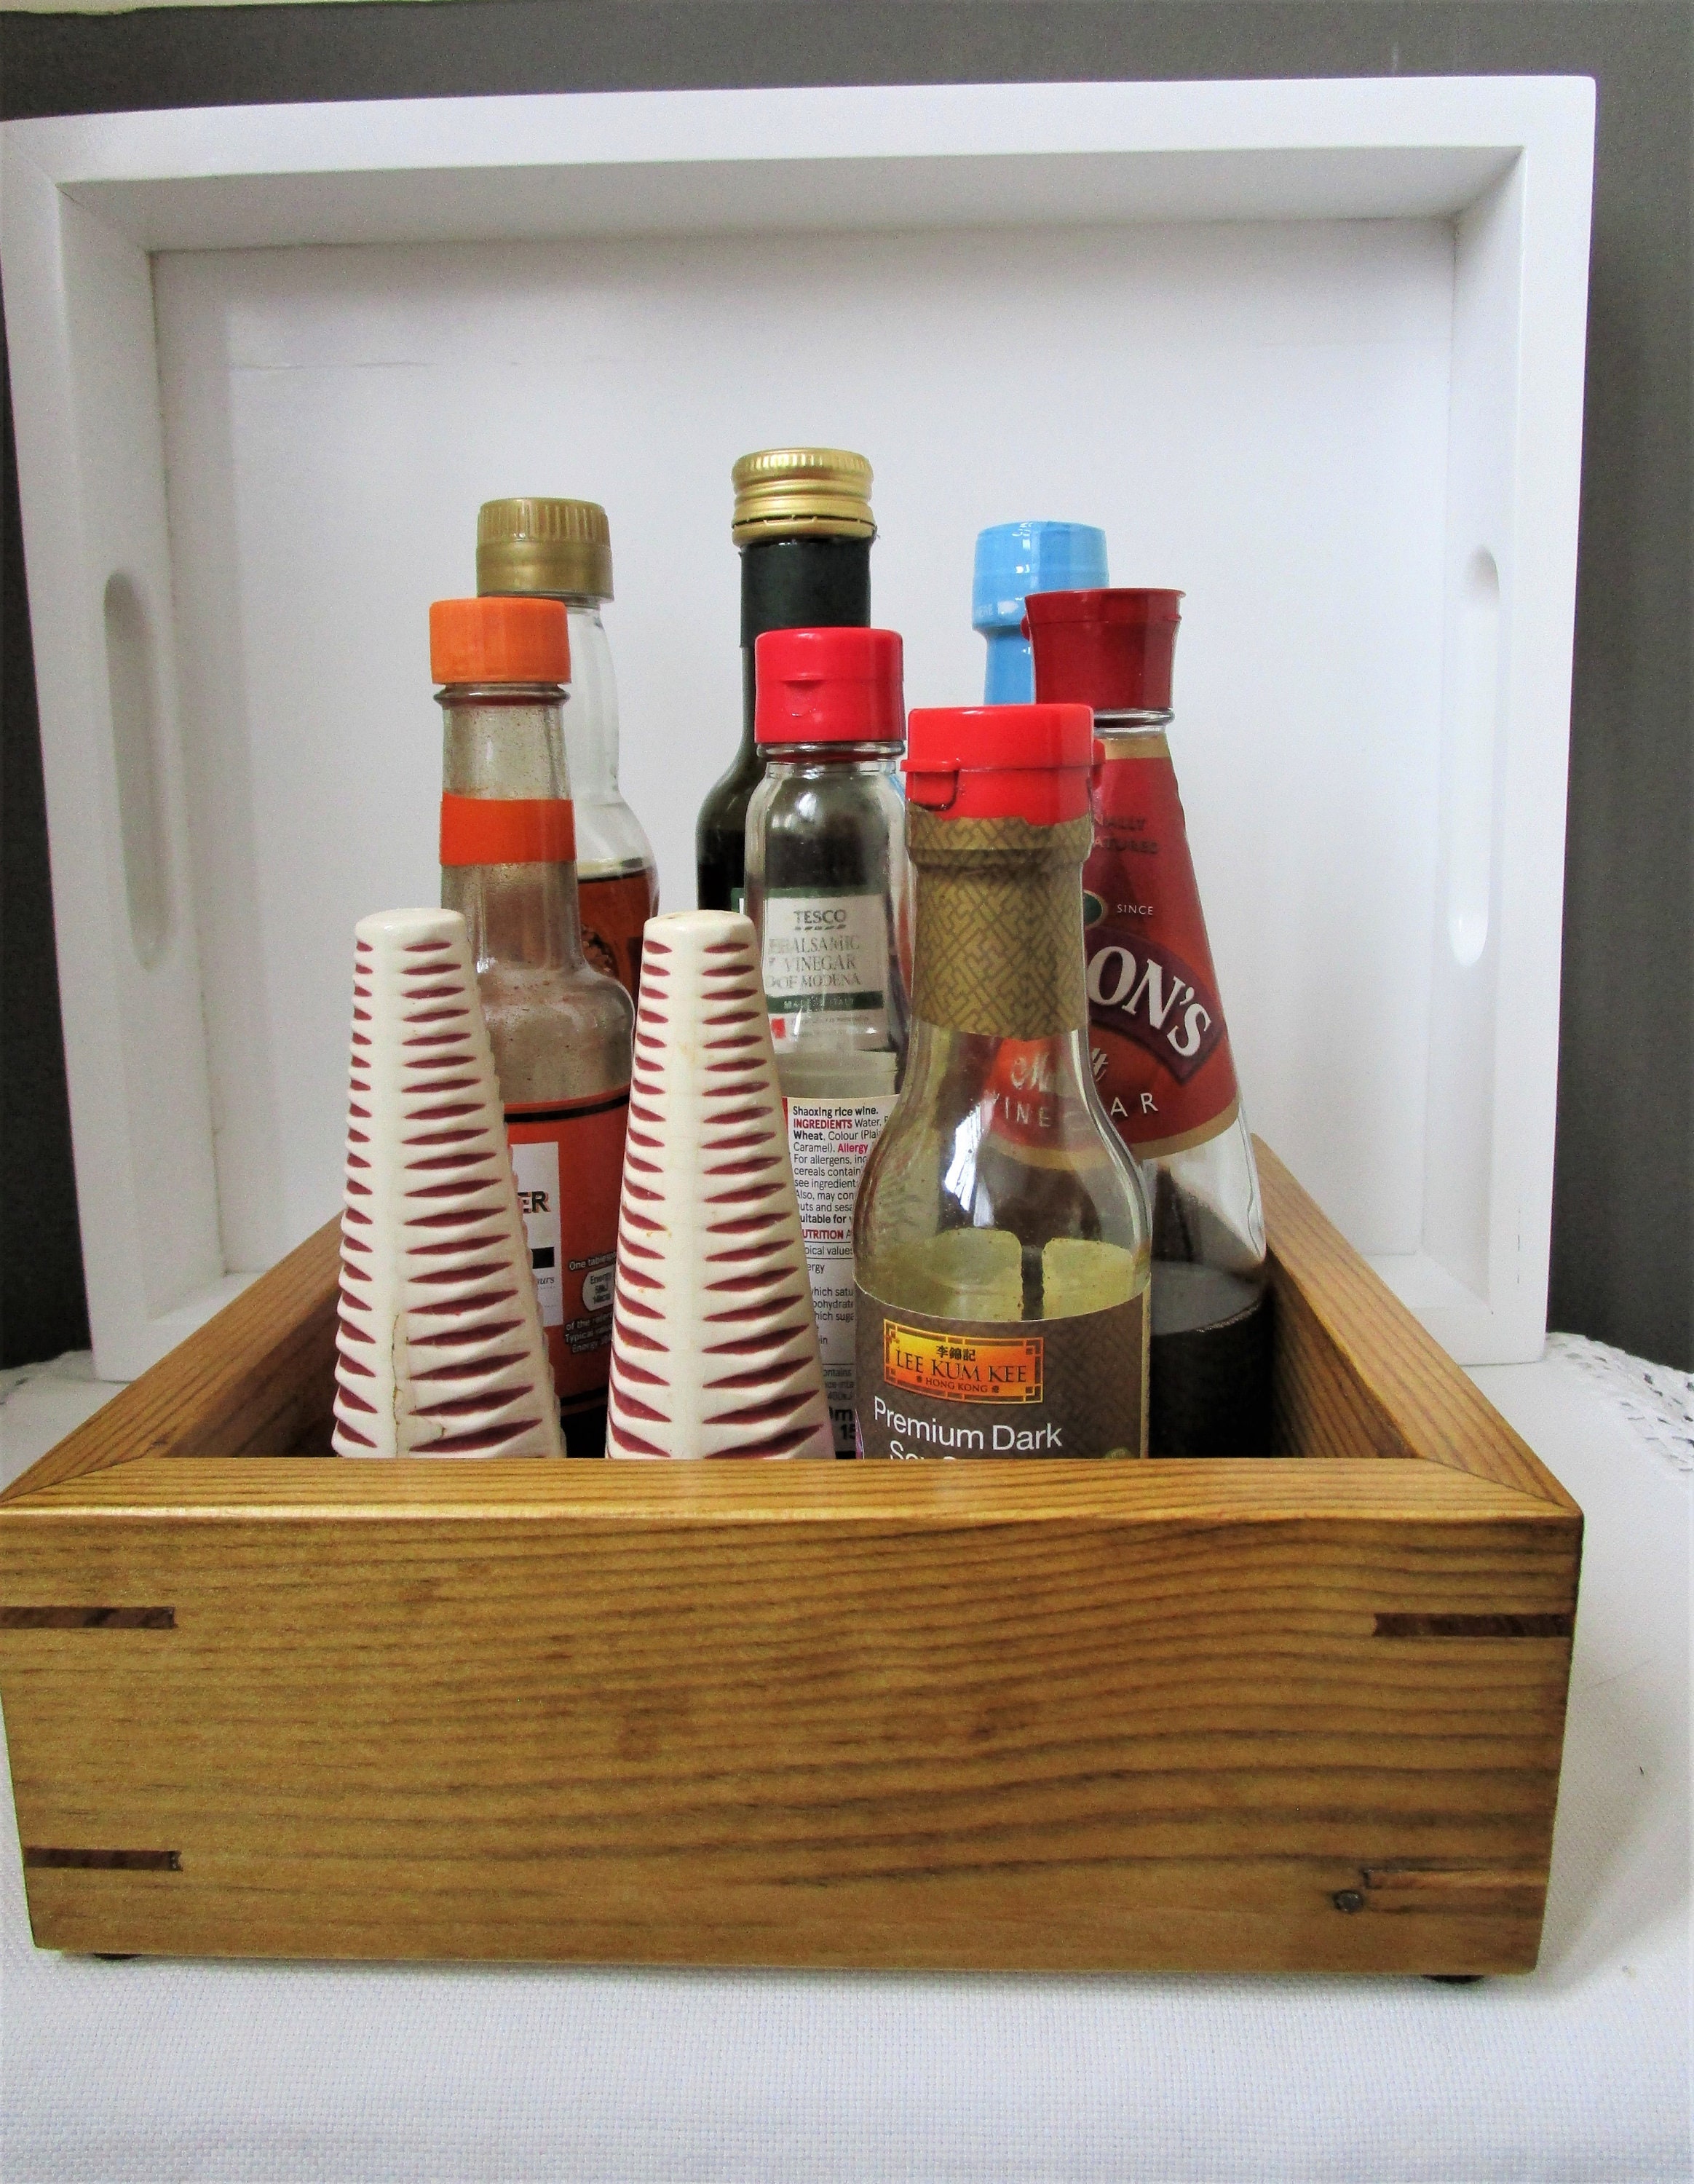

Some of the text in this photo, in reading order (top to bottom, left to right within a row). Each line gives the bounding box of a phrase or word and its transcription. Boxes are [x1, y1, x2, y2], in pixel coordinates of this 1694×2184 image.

[1117, 904, 1154, 916] SINCE
[794, 909, 847, 925] TESCO
[1088, 946, 1212, 1057] ON'S
[793, 1106, 879, 1118] Shaoxing rice wine.
[793, 1119, 853, 1129] INGREDIENTS
[828, 1131, 859, 1141] Colour
[860, 1129, 881, 1141] (Plai
[793, 1142, 868, 1155] Caramel). Allergy
[793, 1154, 808, 1164] For
[855, 1155, 867, 1164] inc
[793, 1167, 862, 1176] cereals contain
[794, 1179, 858, 1190] see ingredient
[518, 1190, 551, 1214] ER
[818, 1192, 835, 1202] may
[837, 1192, 854, 1200] con
[799, 1202, 852, 1212] uts and sesa
[800, 1213, 831, 1224] uitable
[833, 1214, 847, 1224] for
[802, 1229, 844, 1240] UTRITION
[569, 1260, 587, 1270] One
[808, 1263, 825, 1274] ergy
[812, 1286, 853, 1297] hich satu
[815, 1312, 833, 1321] hich
[565, 1321, 574, 1331] of
[896, 1349, 1027, 1382] LEE KUM KEE
[925, 1377, 989, 1393] HONG KONG
[874, 1395, 984, 1450] Premium
[992, 1422, 1063, 1450] Dark
